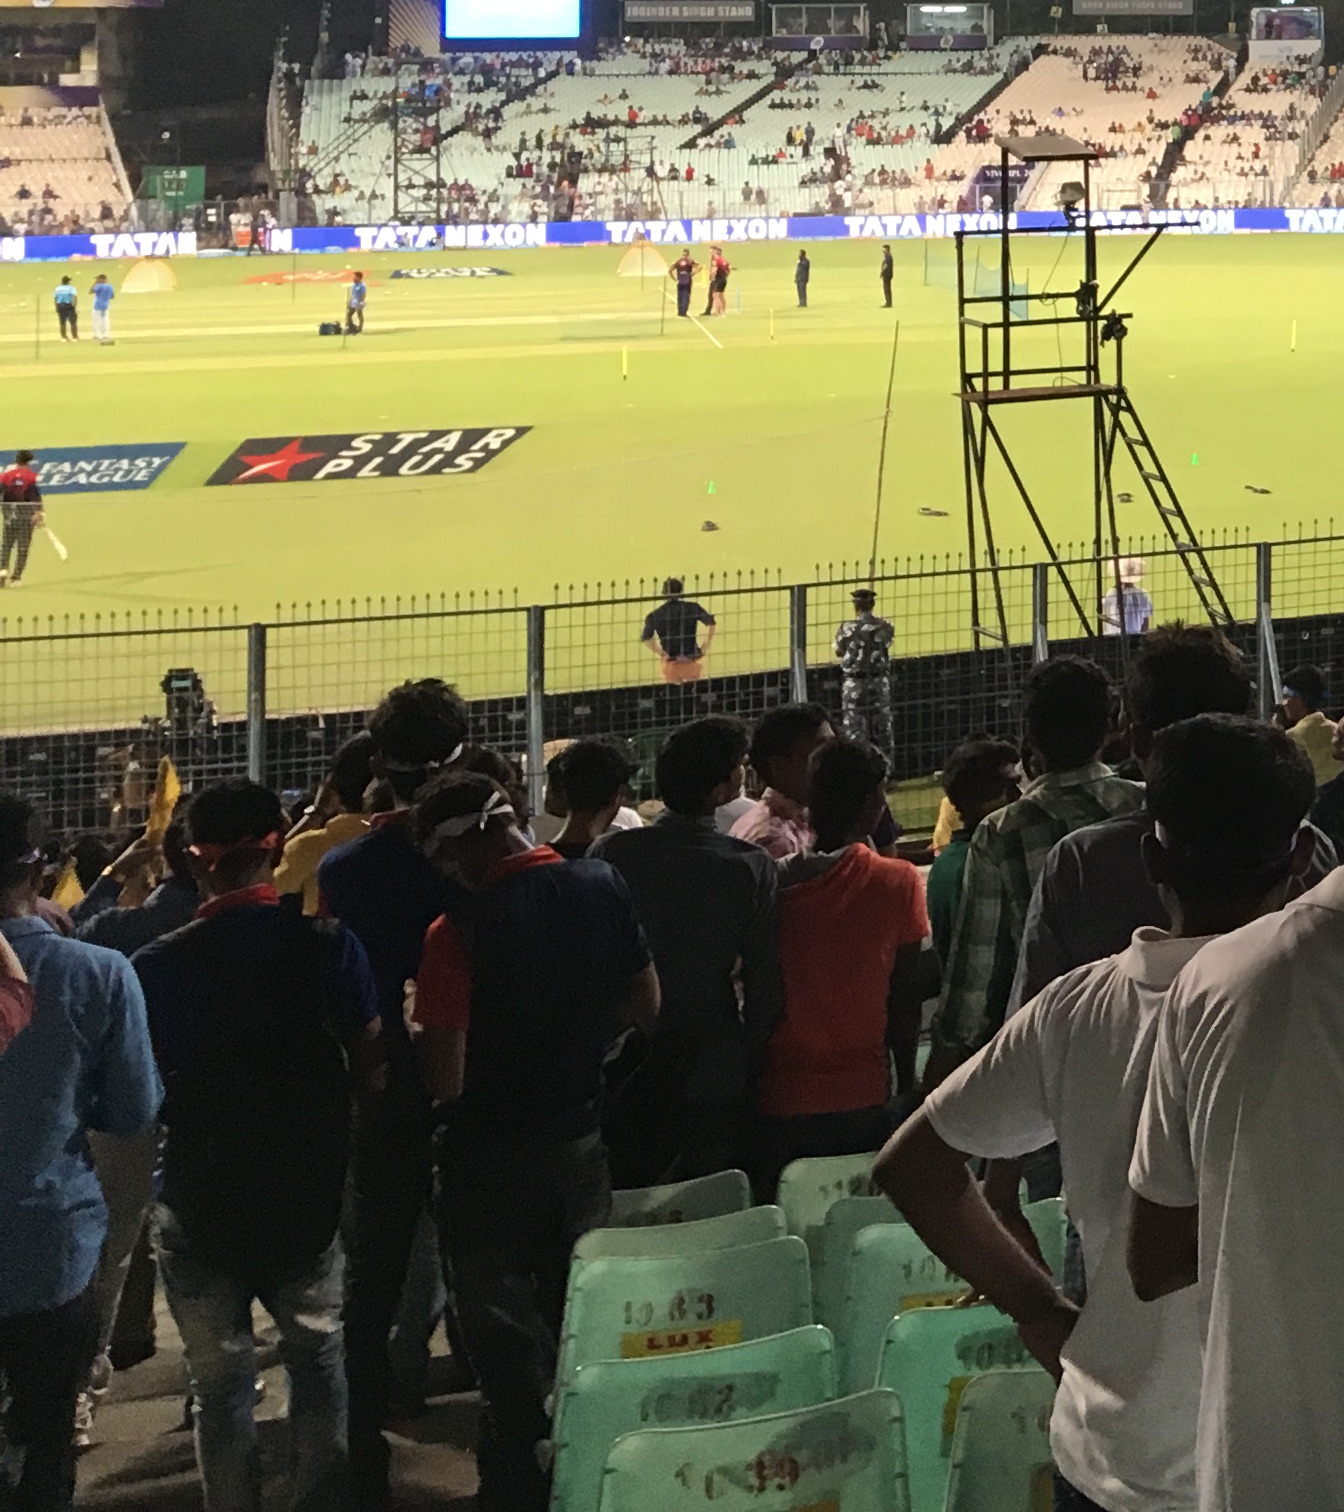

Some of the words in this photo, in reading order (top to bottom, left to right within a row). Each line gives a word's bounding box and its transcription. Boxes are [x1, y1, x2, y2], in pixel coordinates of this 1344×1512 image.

[717, 5, 753, 17] STAND
[605, 221, 687, 242] TATA
[692, 218, 788, 241] NEXON
[844, 215, 922, 237] TATA
[355, 227, 441, 249] TATA
[336, 427, 517, 458] STAR
[39, 455, 171, 475] FANTASY
[312, 452, 488, 480] PLUS
[36, 468, 156, 487] LEAGUE
[646, 1329, 714, 1351] LUX
